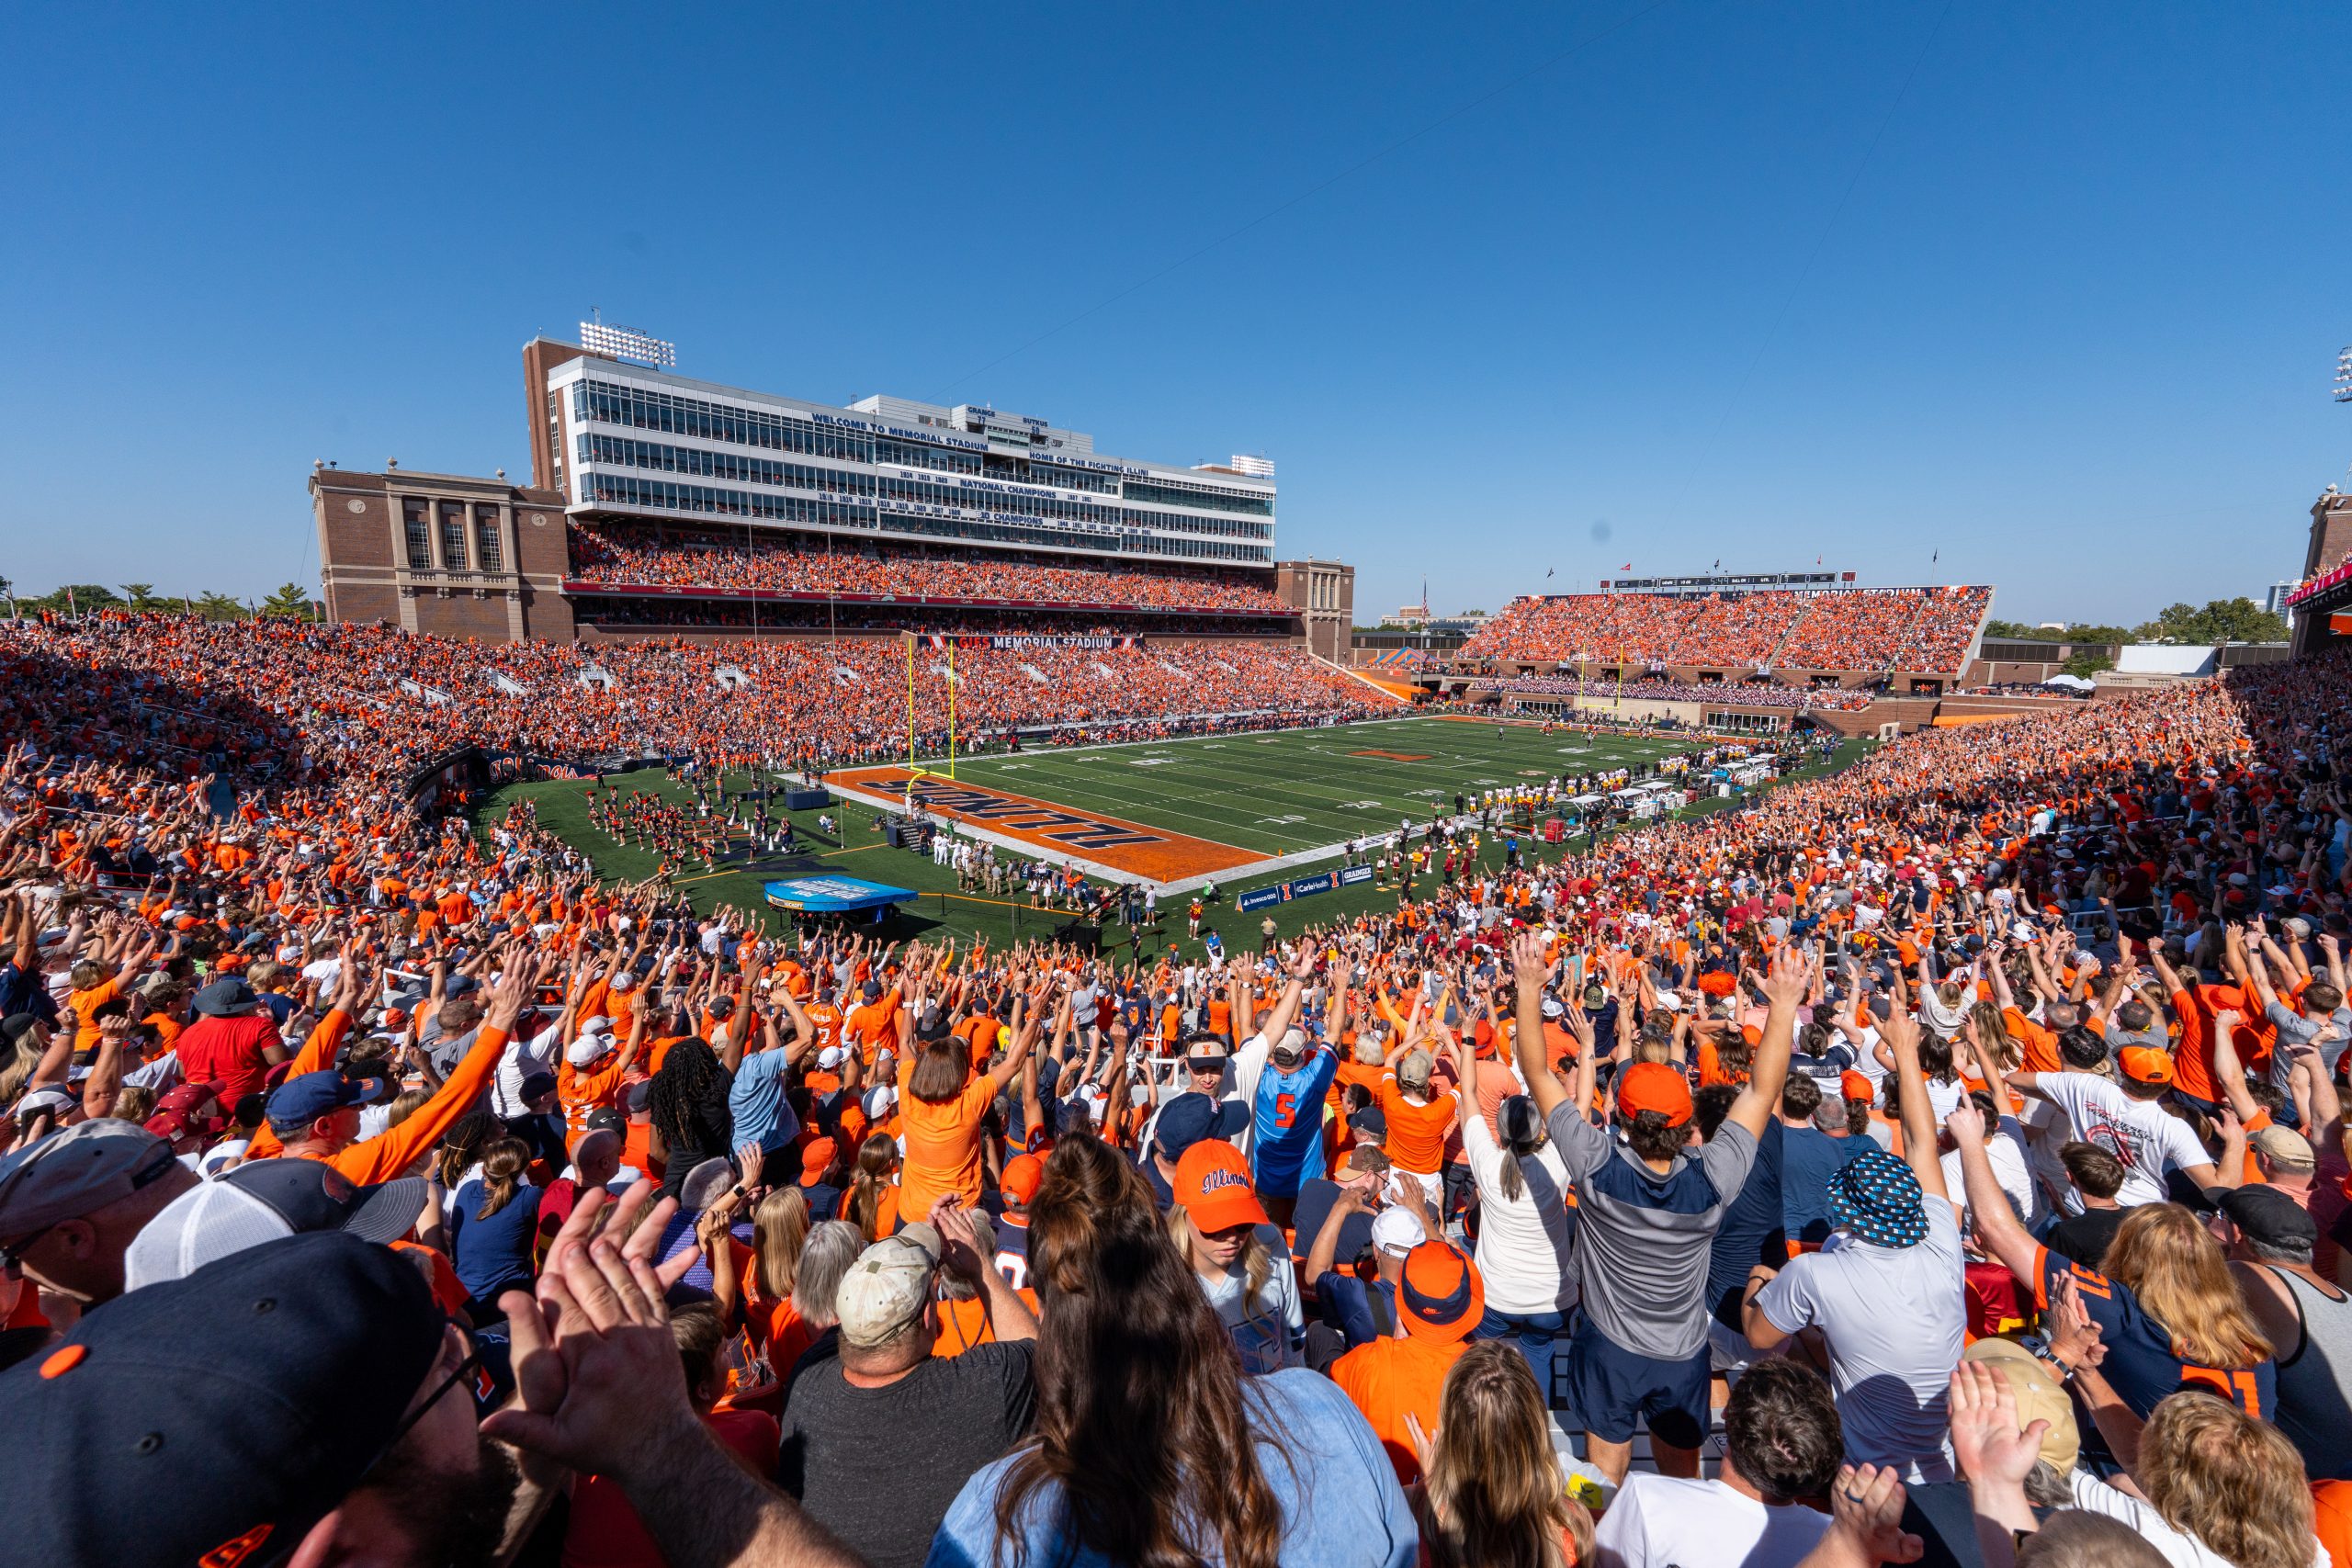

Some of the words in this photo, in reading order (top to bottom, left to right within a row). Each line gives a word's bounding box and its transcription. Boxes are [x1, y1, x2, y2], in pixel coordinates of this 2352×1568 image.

[967, 406, 995, 417] GRANGE
[1023, 417, 1048, 427] BUTKUS
[1031, 426, 1040, 434] 50
[812, 413, 867, 430] WELCOME
[870, 423, 885, 434] TO
[888, 427, 944, 444] MEMORIAL
[946, 437, 989, 452] STADIUM
[1029, 452, 1054, 462] HOME
[1057, 456, 1068, 464] OF
[1069, 458, 1086, 468] THE
[1088, 461, 1125, 473] FIGHTING
[1126, 467, 1148, 477] ILLINI
[960, 479, 1005, 492] NATIONAL
[1008, 486, 1057, 499] CHAMPIONS
[994, 513, 1044, 525] CHAMPIONS
[1794, 589, 1856, 598] MEMORIAL
[958, 637, 990, 649] GIES
[993, 637, 1057, 649] MEMORIAL
[1063, 637, 1113, 649] STADIUM
[490, 758, 579, 784] Illnois
[1330, 872, 1339, 888] I
[1344, 867, 1372, 879] GRAINGER
[1282, 884, 1292, 901] I
[818, 1028, 831, 1044] 7
[1203, 1045, 1211, 1055] I
[1275, 1093, 1296, 1128] 5
[1202, 1168, 1250, 1194] Illinoi
